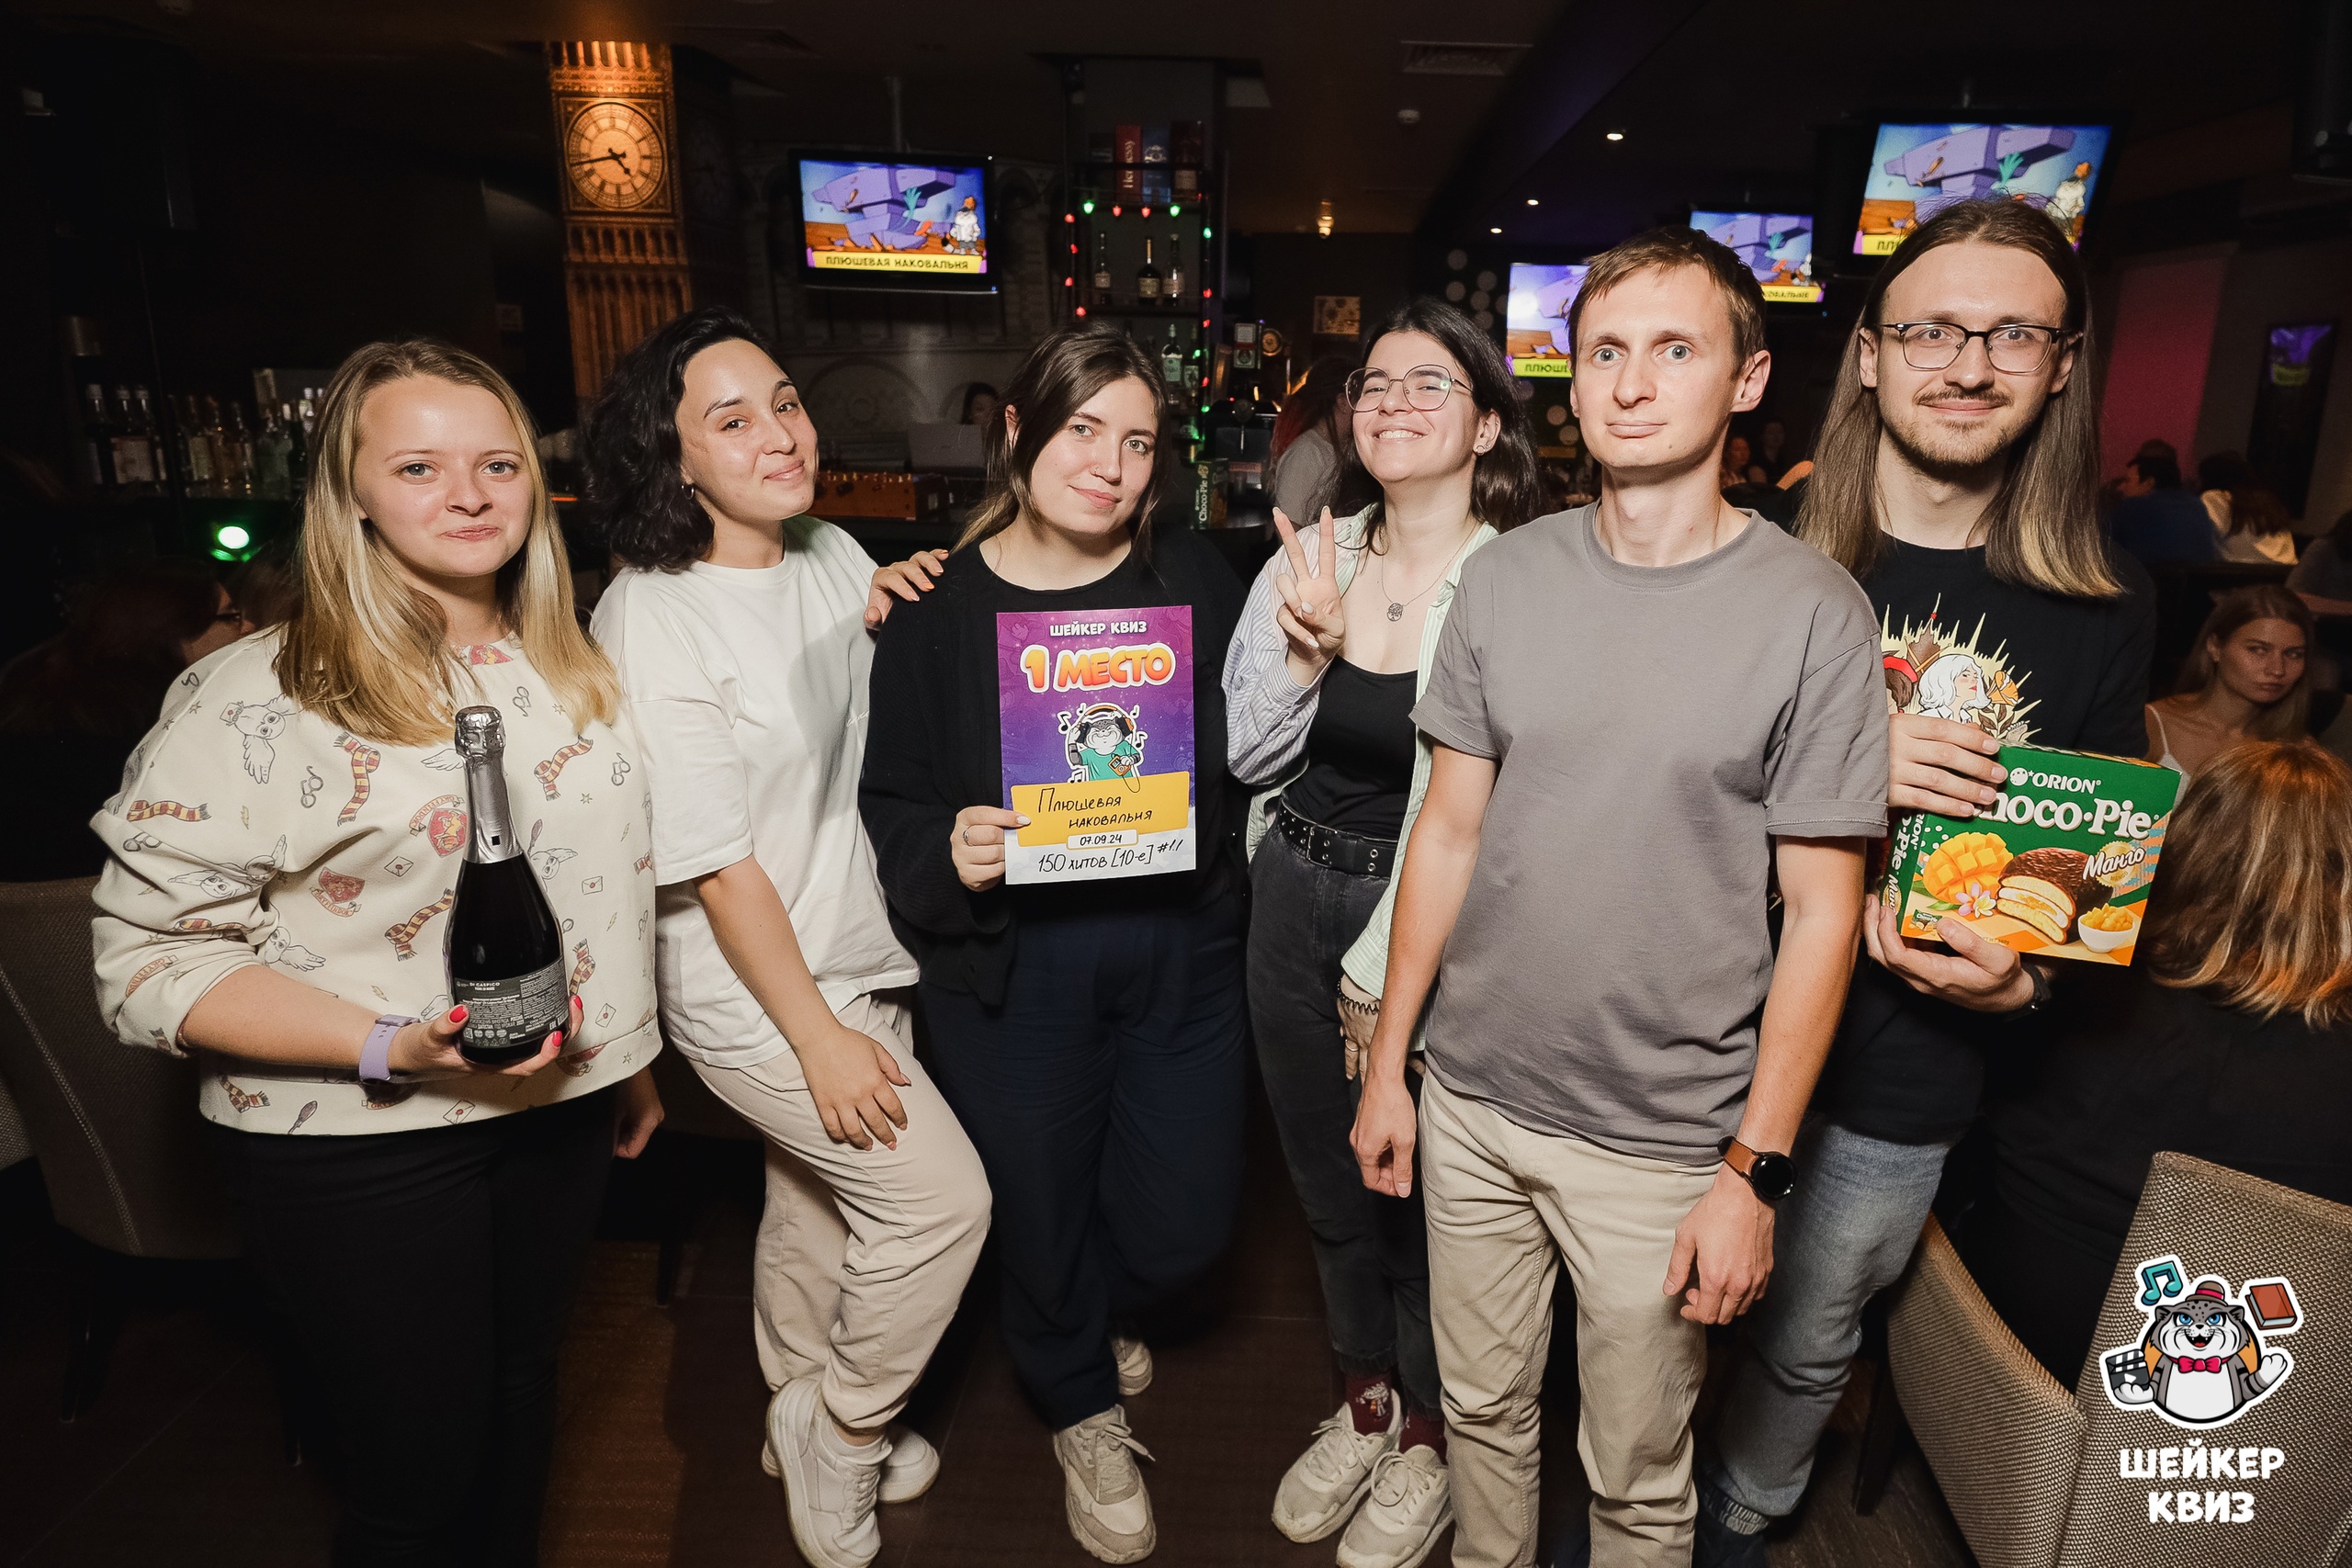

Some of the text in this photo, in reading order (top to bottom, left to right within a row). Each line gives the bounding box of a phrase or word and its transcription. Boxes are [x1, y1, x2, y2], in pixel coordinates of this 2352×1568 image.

[825, 256, 969, 269] ПЛЮШЕВАЯ НАКОВАЛЬНЯ
[1049, 621, 1148, 637] ШЕЙКЕР КВИЗ
[1023, 646, 1173, 689] 1 МЕСТО
[1080, 834, 1123, 846] 07.09.24
[1910, 814, 1925, 849] RION
[1038, 853, 1066, 873] 150
[2082, 847, 2145, 880] Манго
